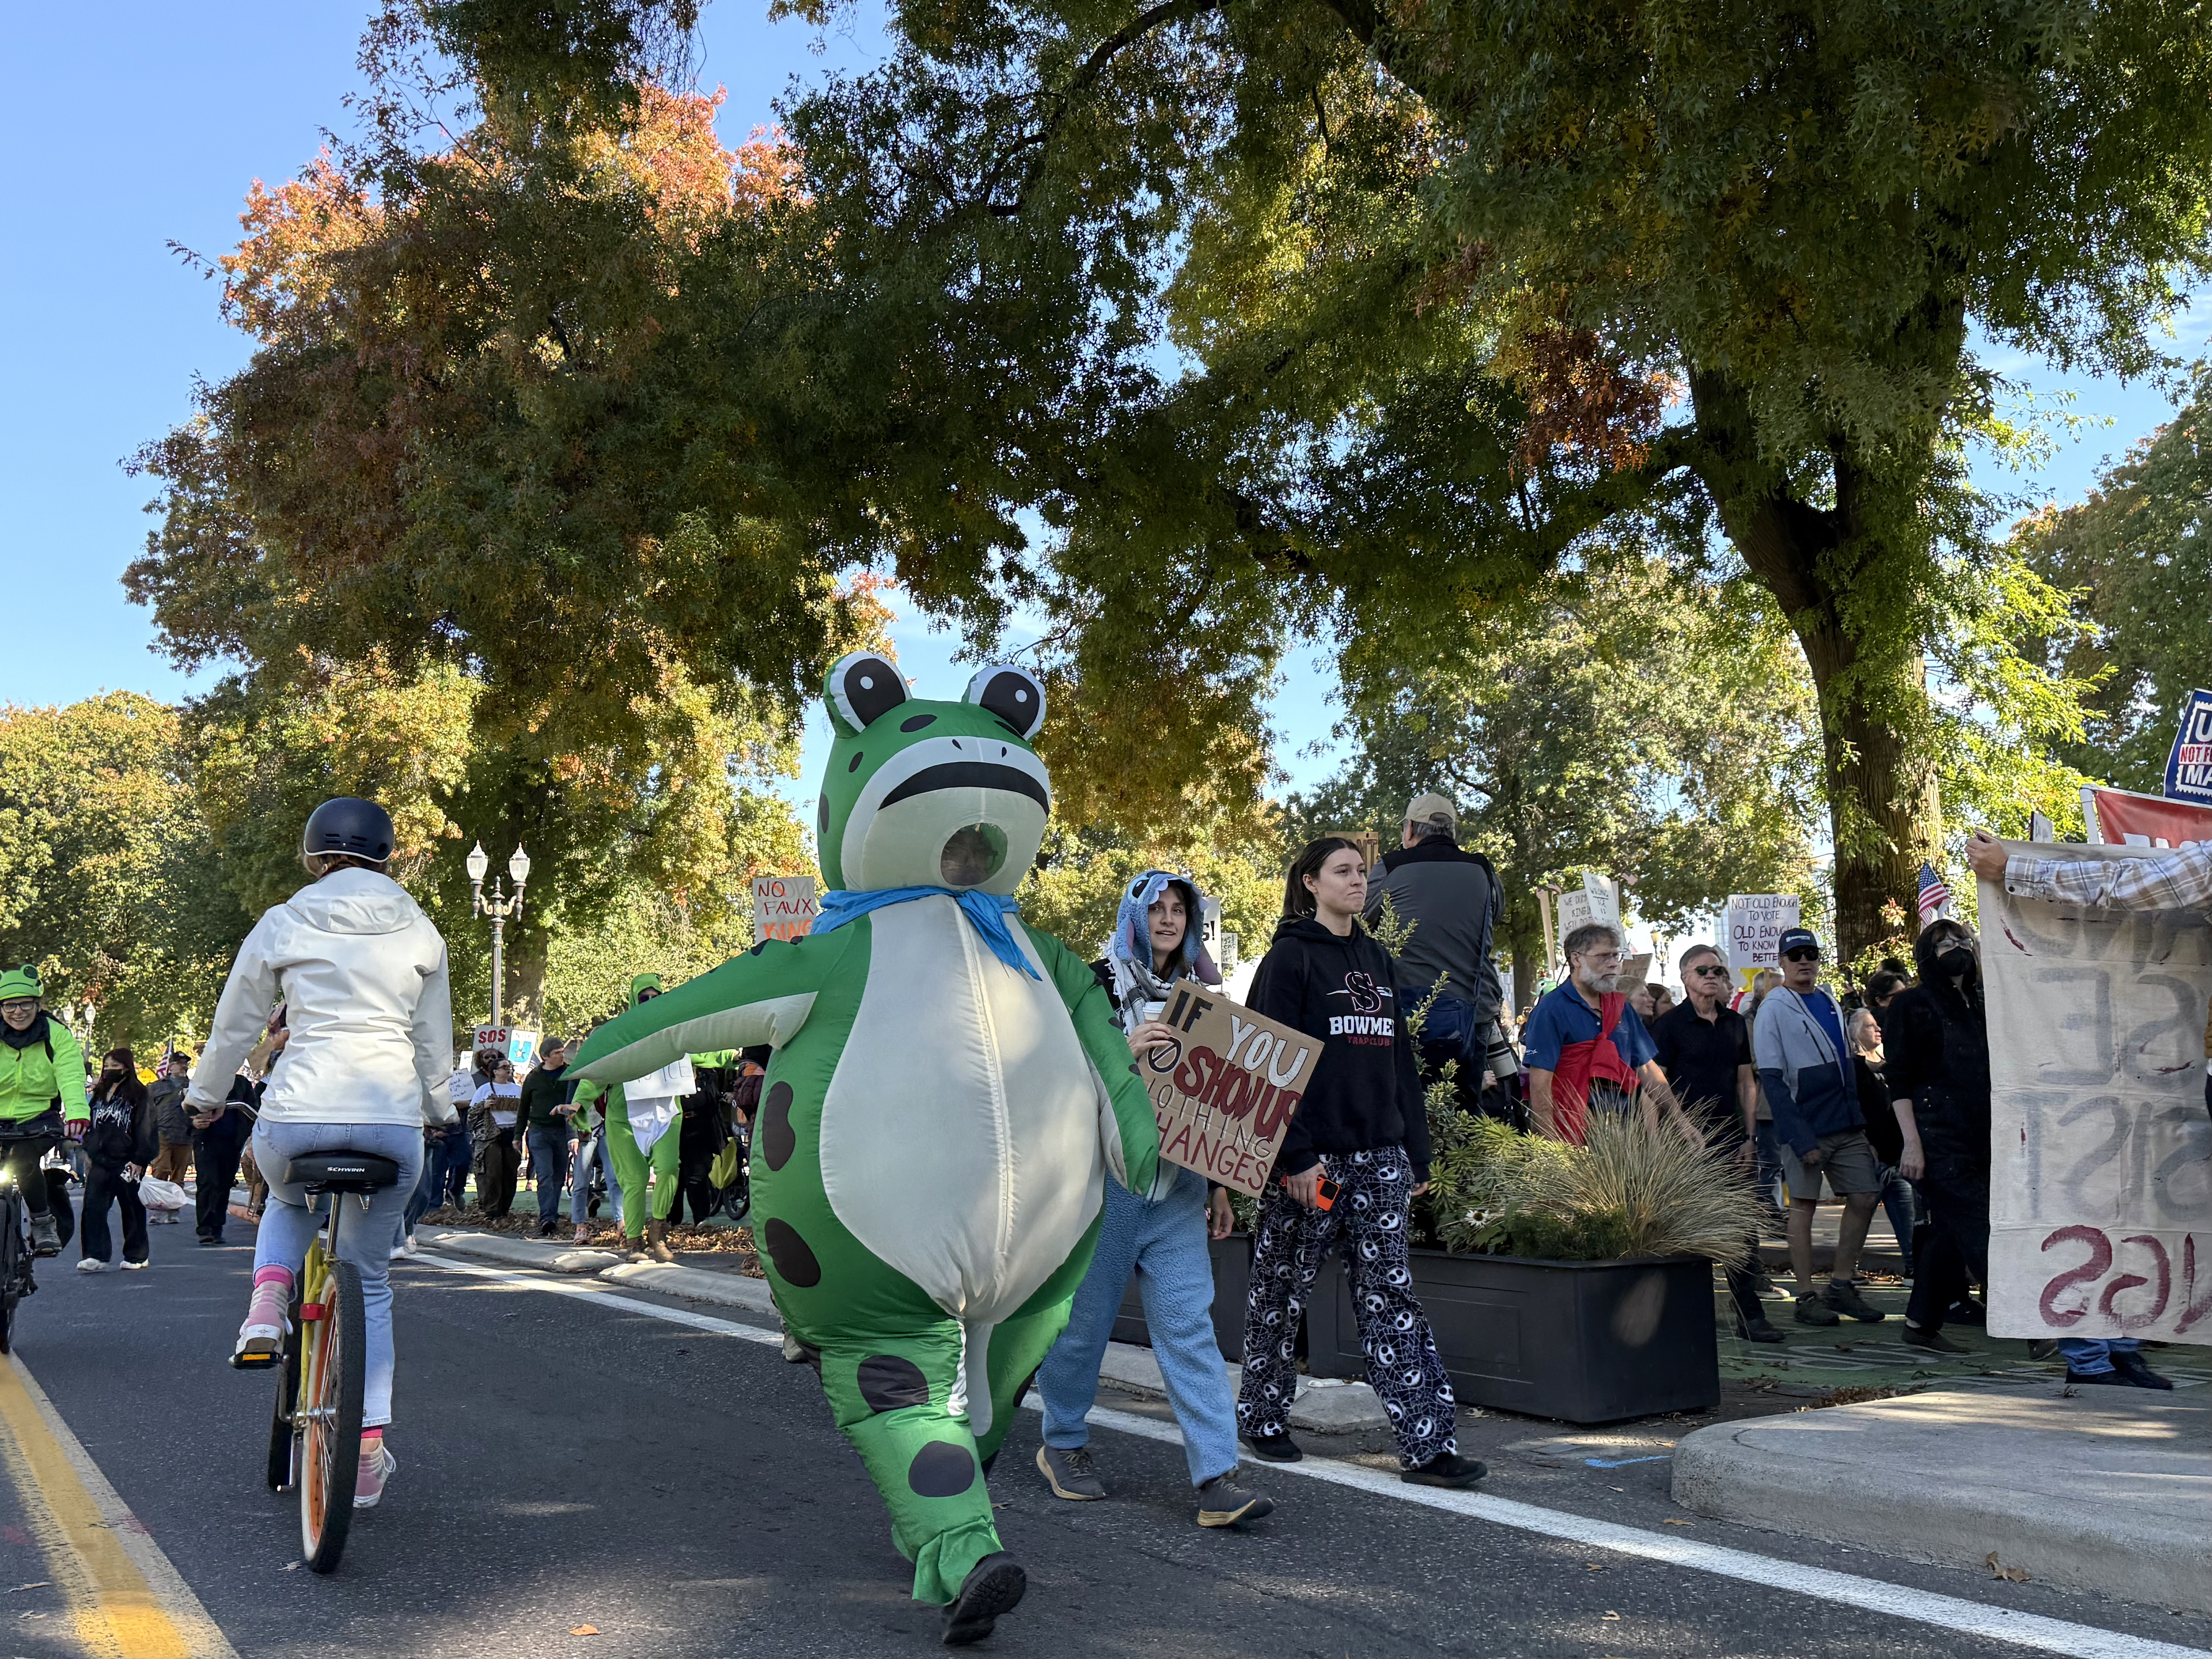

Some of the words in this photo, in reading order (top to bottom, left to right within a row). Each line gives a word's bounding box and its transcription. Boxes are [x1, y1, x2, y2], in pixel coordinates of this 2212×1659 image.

[2180, 746, 2203, 762] NOT
[759, 880, 785, 898] NO
[764, 898, 814, 916] FAUX
[1732, 898, 1751, 910] NOT
[1753, 898, 1770, 909] OLD
[1773, 897, 1798, 908] ENOUGH
[1748, 910, 1759, 920] TO
[1761, 910, 1780, 921] VOTE
[1734, 925, 1755, 939] OLD
[1760, 925, 1792, 938] ENOUG
[1737, 941, 1749, 951] TO
[1752, 940, 1776, 950] KNOW
[1753, 953, 1779, 962] BETTE
[1329, 1015, 1394, 1037] BOWME
[478, 1029, 506, 1044] SOS
[1167, 990, 1213, 1033] IF
[1226, 1013, 1309, 1088] YOU
[1148, 1078, 1272, 1161] OTHING
[1158, 1112, 1268, 1190] HANGES
